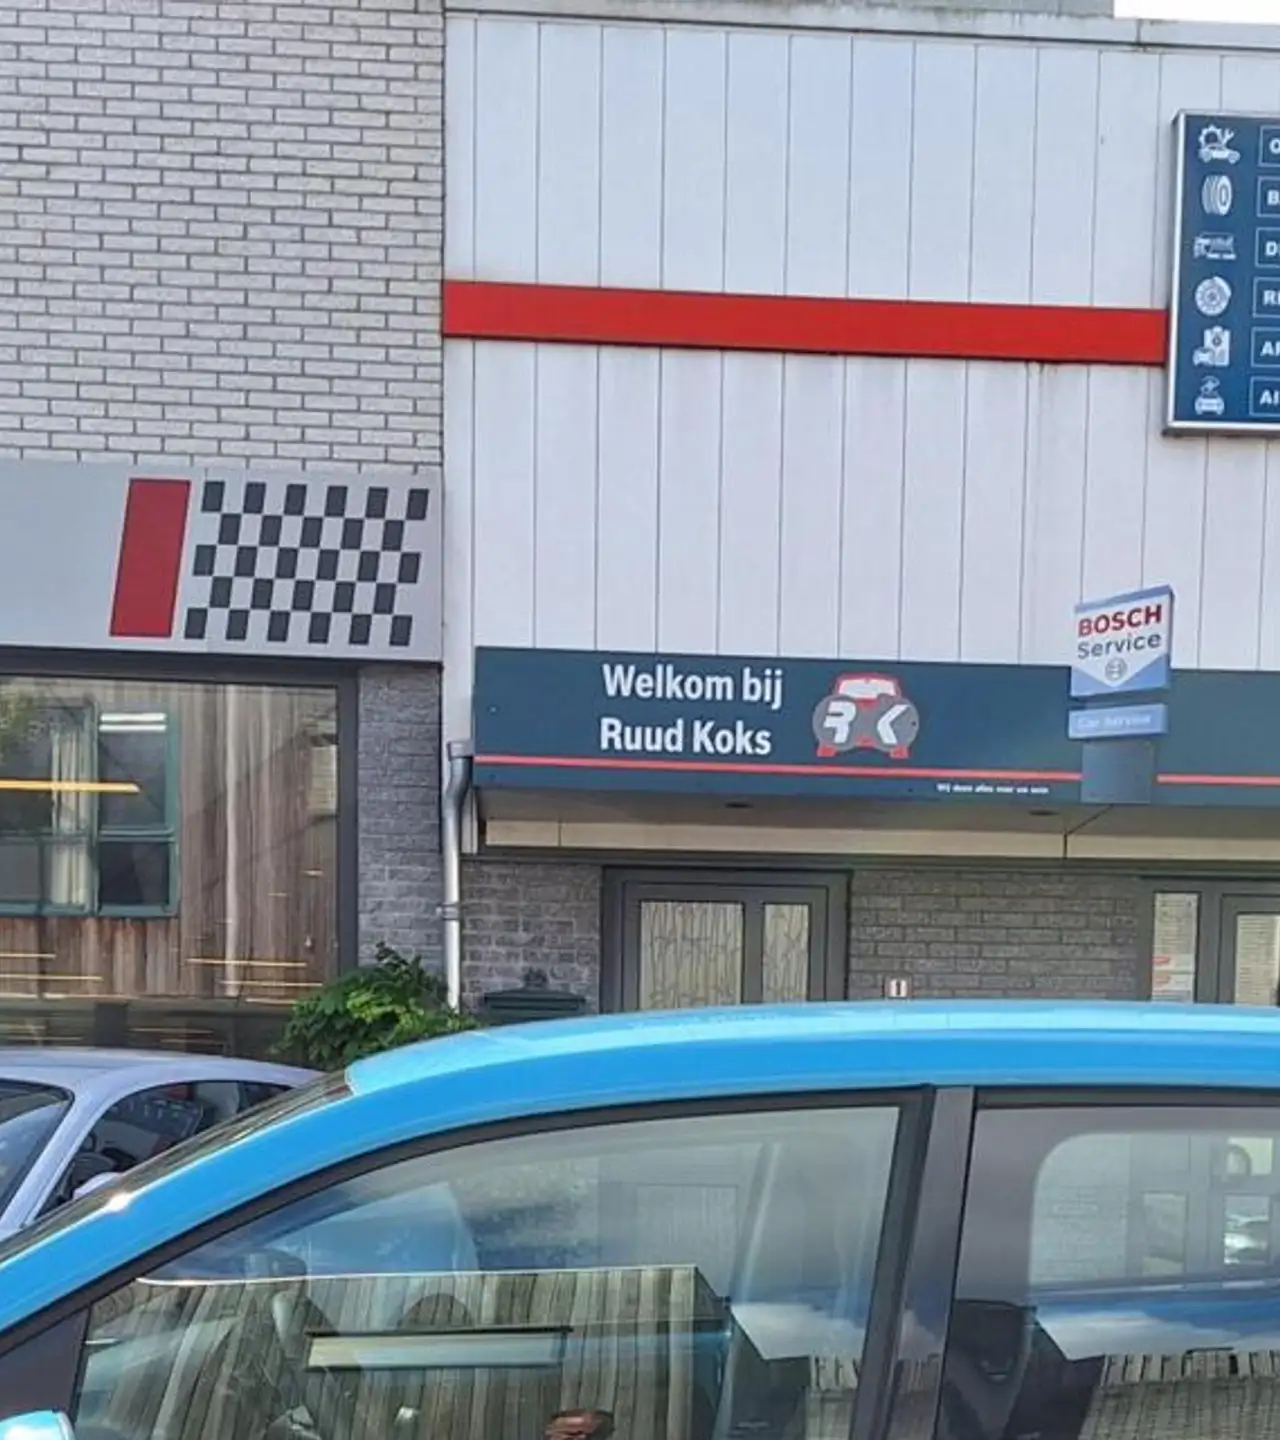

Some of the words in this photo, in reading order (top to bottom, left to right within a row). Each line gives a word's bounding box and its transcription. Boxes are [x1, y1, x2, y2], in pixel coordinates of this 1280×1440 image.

[1078, 603, 1162, 637] BOSCH
[1077, 633, 1162, 660] Service
[602, 663, 733, 700] Welkom
[742, 666, 783, 710] bij
[599, 717, 683, 752] Ruud
[693, 719, 773, 755] Koks
